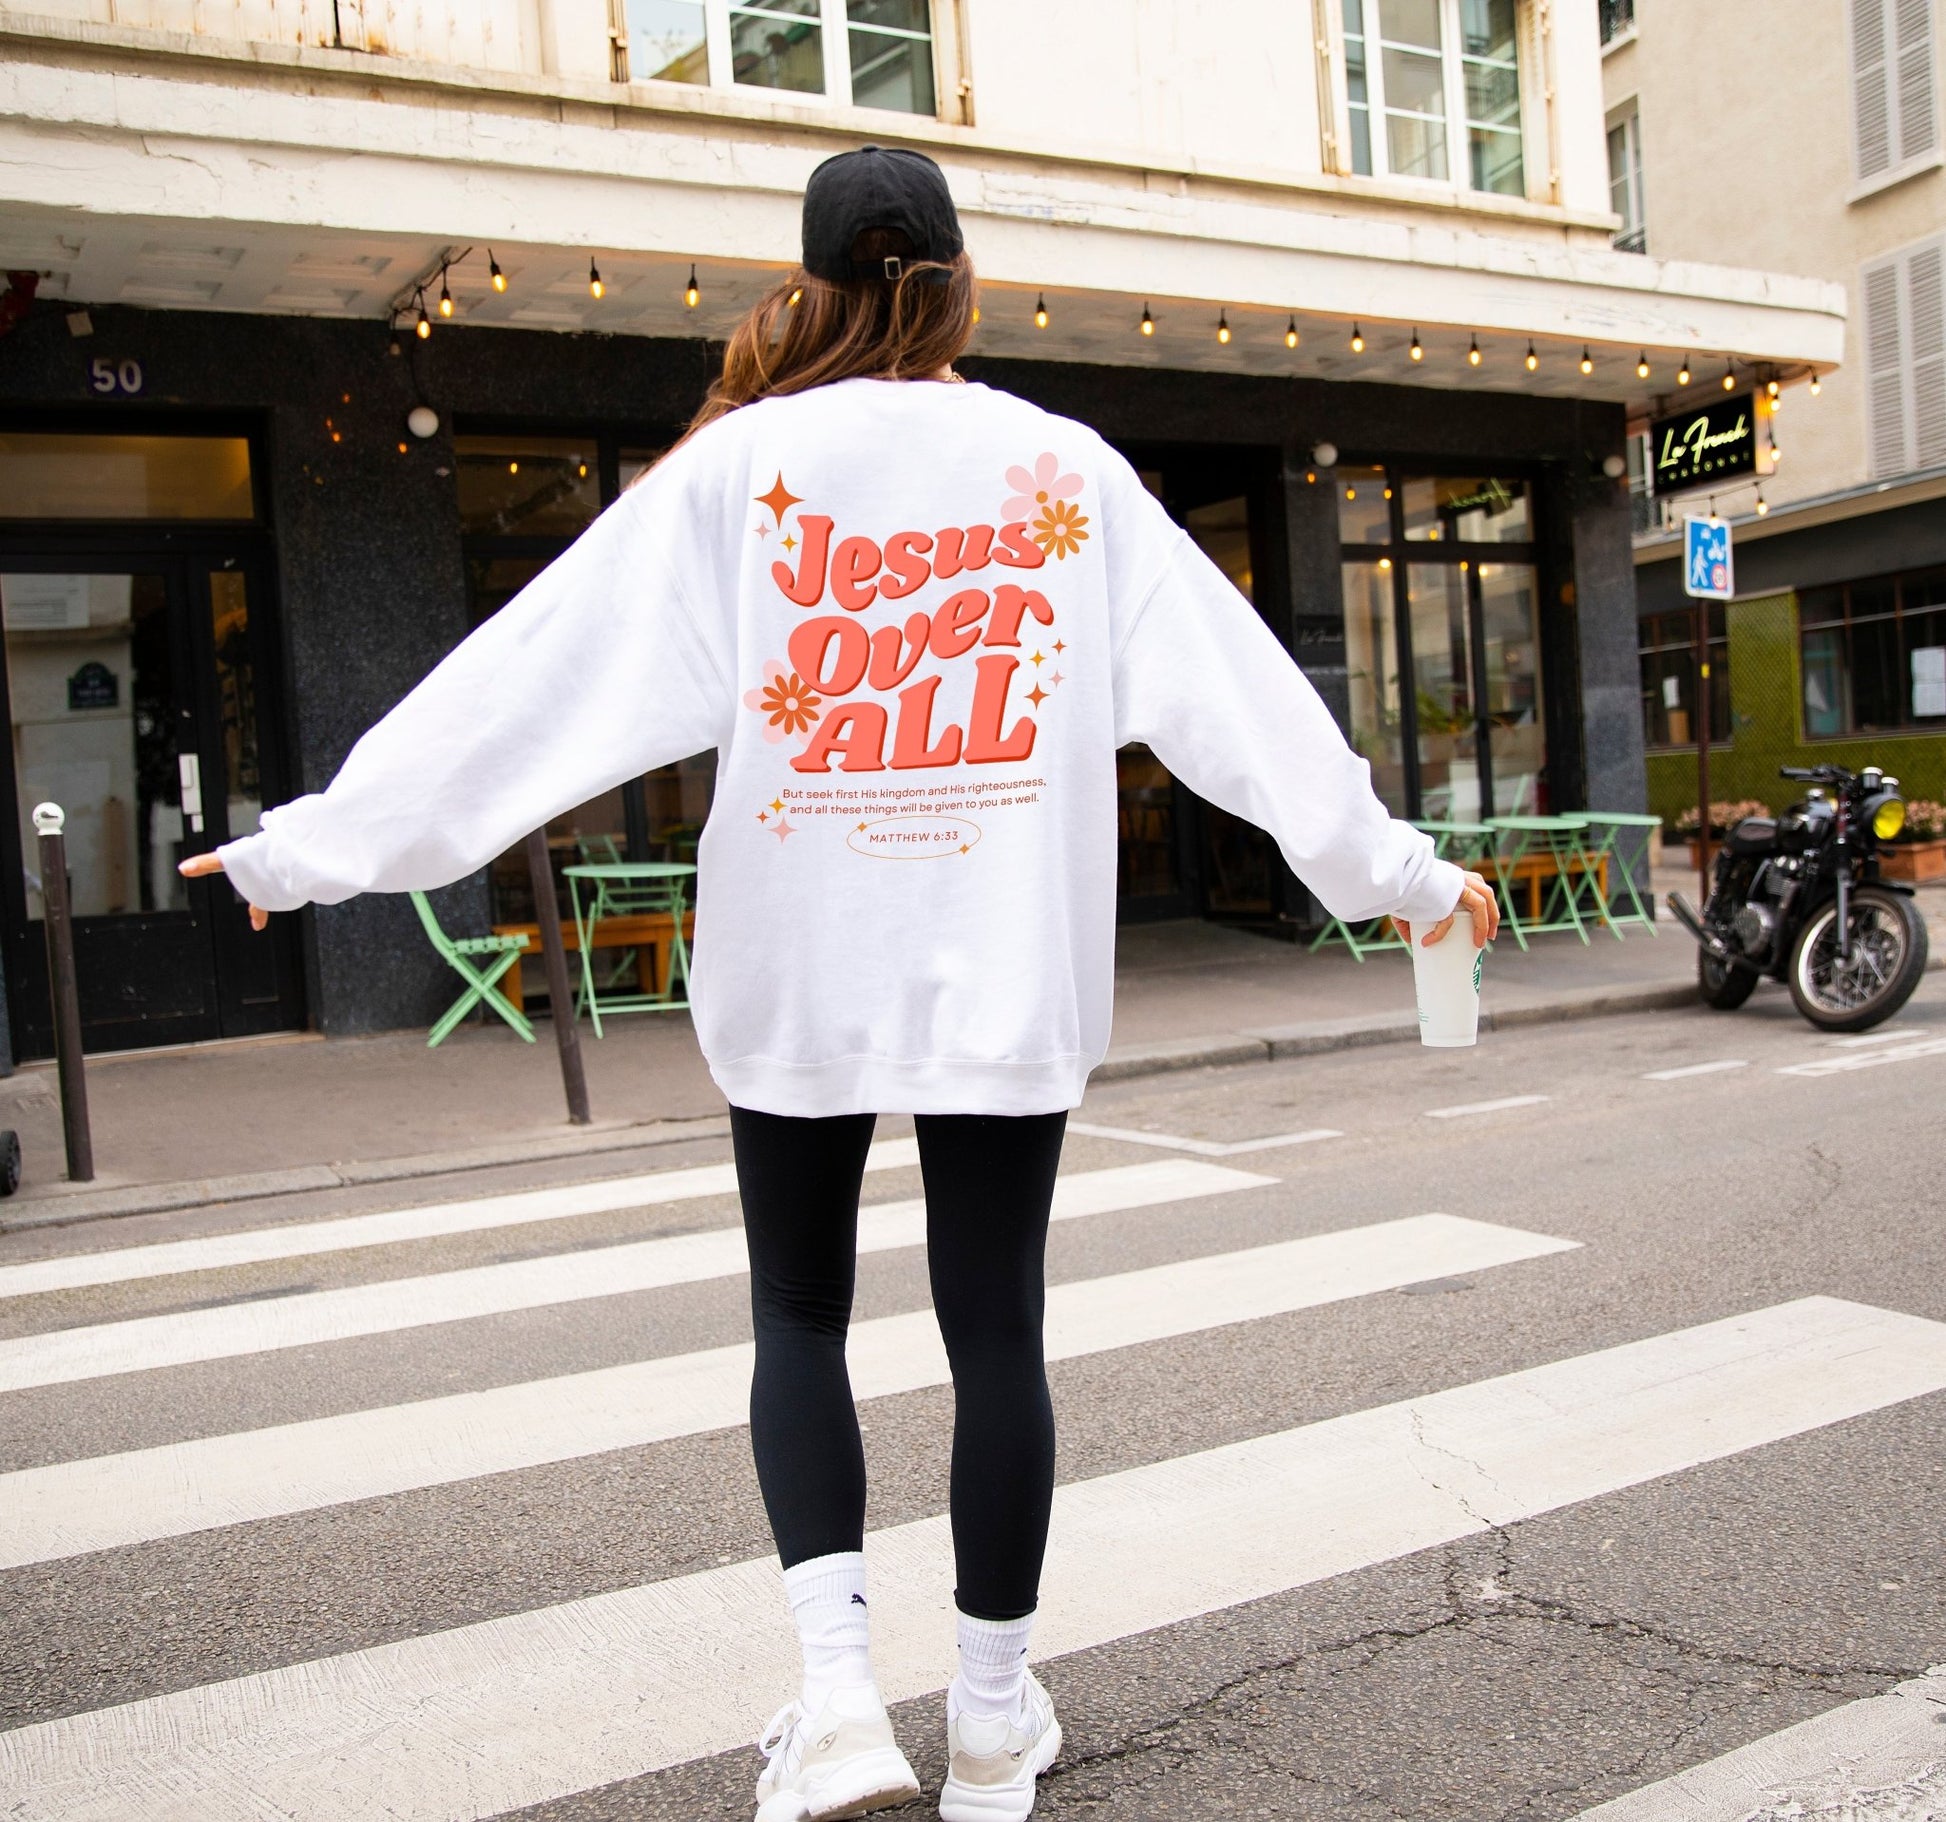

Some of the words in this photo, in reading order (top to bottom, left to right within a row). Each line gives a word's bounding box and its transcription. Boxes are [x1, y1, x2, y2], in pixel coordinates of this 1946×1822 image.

[93, 359, 142, 393] 50
[1657, 428, 1687, 469] La
[771, 515, 1046, 611] Jesus
[788, 584, 1054, 696] Over
[789, 654, 1037, 773] ALL
[783, 788, 803, 799] But
[806, 789, 833, 799] seek
[836, 788, 858, 799] first
[861, 788, 877, 799] His
[880, 787, 925, 800] kingdom
[928, 785, 948, 796] and
[950, 784, 965, 795] His
[968, 778, 1047, 795] righteousness,
[790, 805, 812, 815] and
[815, 805, 827, 814] all
[831, 805, 861, 815] these
[864, 804, 897, 816] things
[900, 803, 917, 813] will
[919, 803, 932, 812] be
[935, 801, 963, 813] given
[966, 801, 976, 809] to
[979, 800, 998, 810] you
[1000, 798, 1012, 806] as
[1015, 793, 1040, 804] well.
[869, 832, 930, 843] MATTHEW
[934, 831, 958, 842] 6:33
